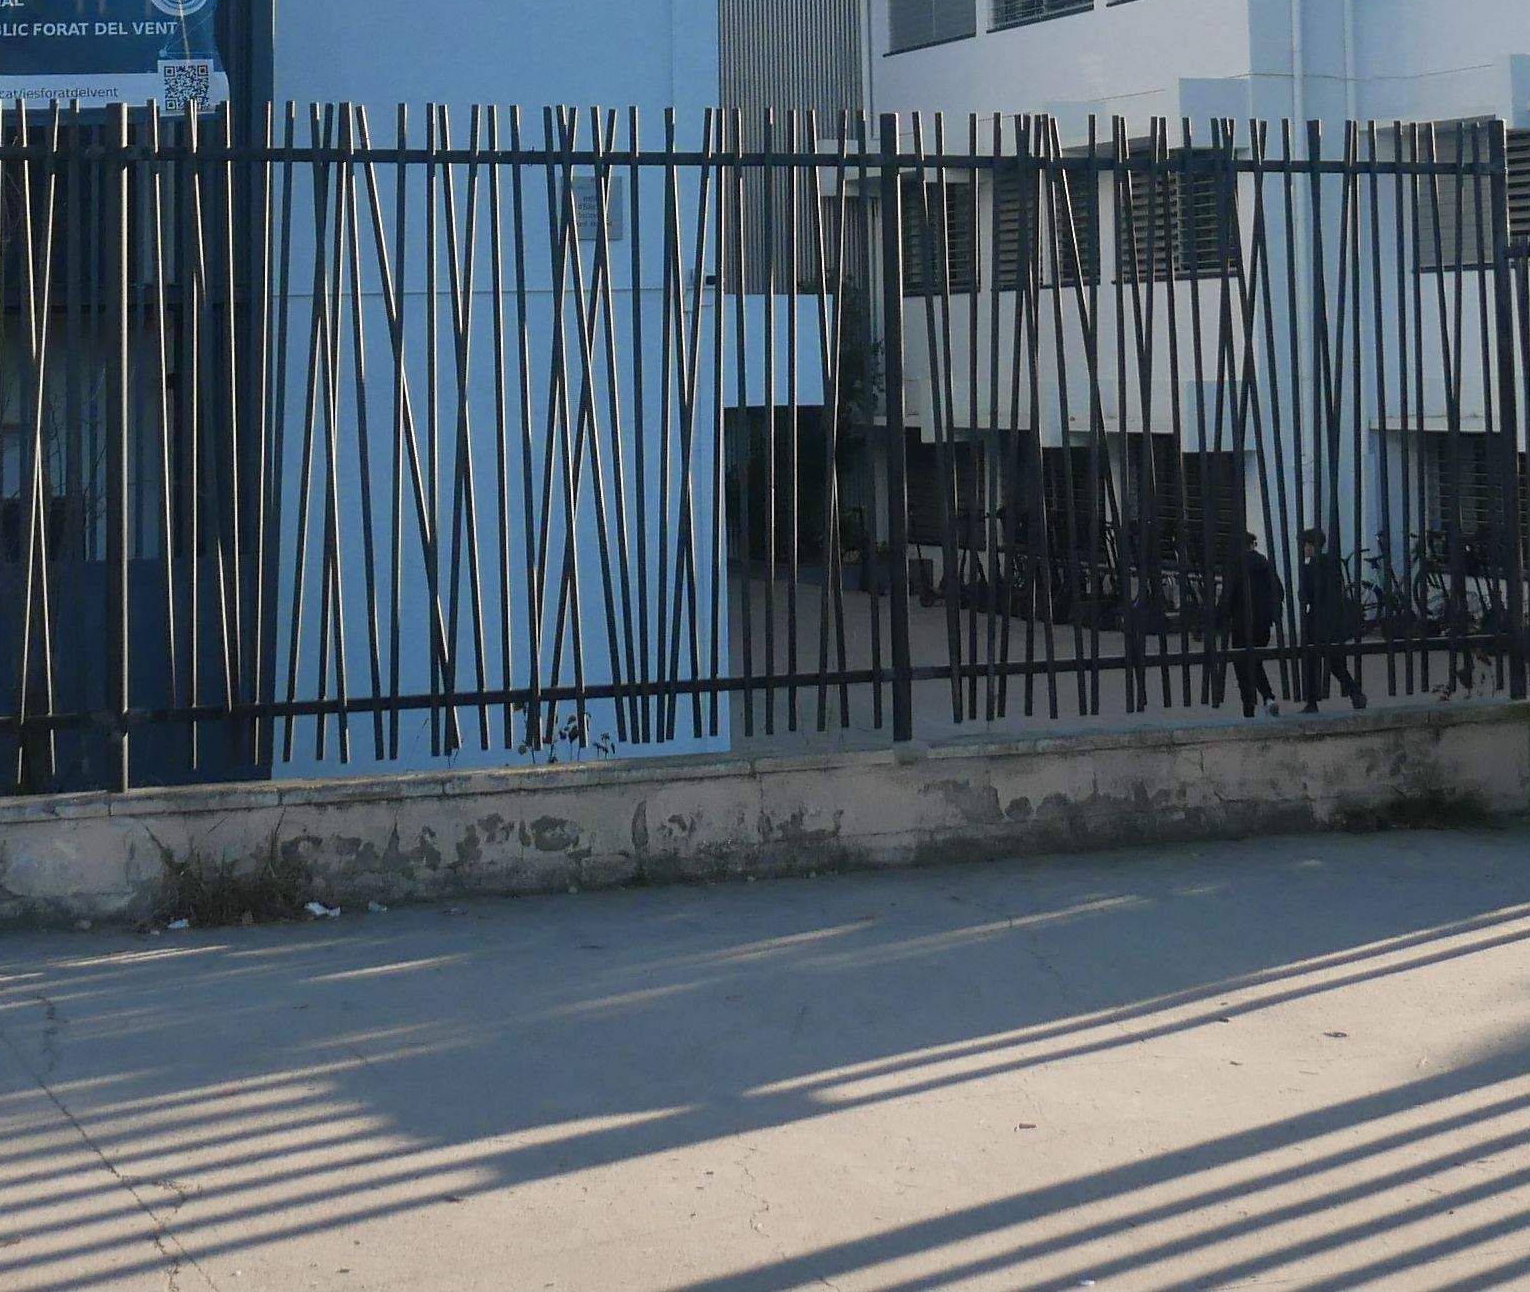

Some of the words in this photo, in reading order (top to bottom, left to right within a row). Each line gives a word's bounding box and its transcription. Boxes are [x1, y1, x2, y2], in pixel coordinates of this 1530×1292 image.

[33, 22, 89, 37] FORAT
[95, 22, 129, 36] DEL
[133, 21, 178, 36] VENT
